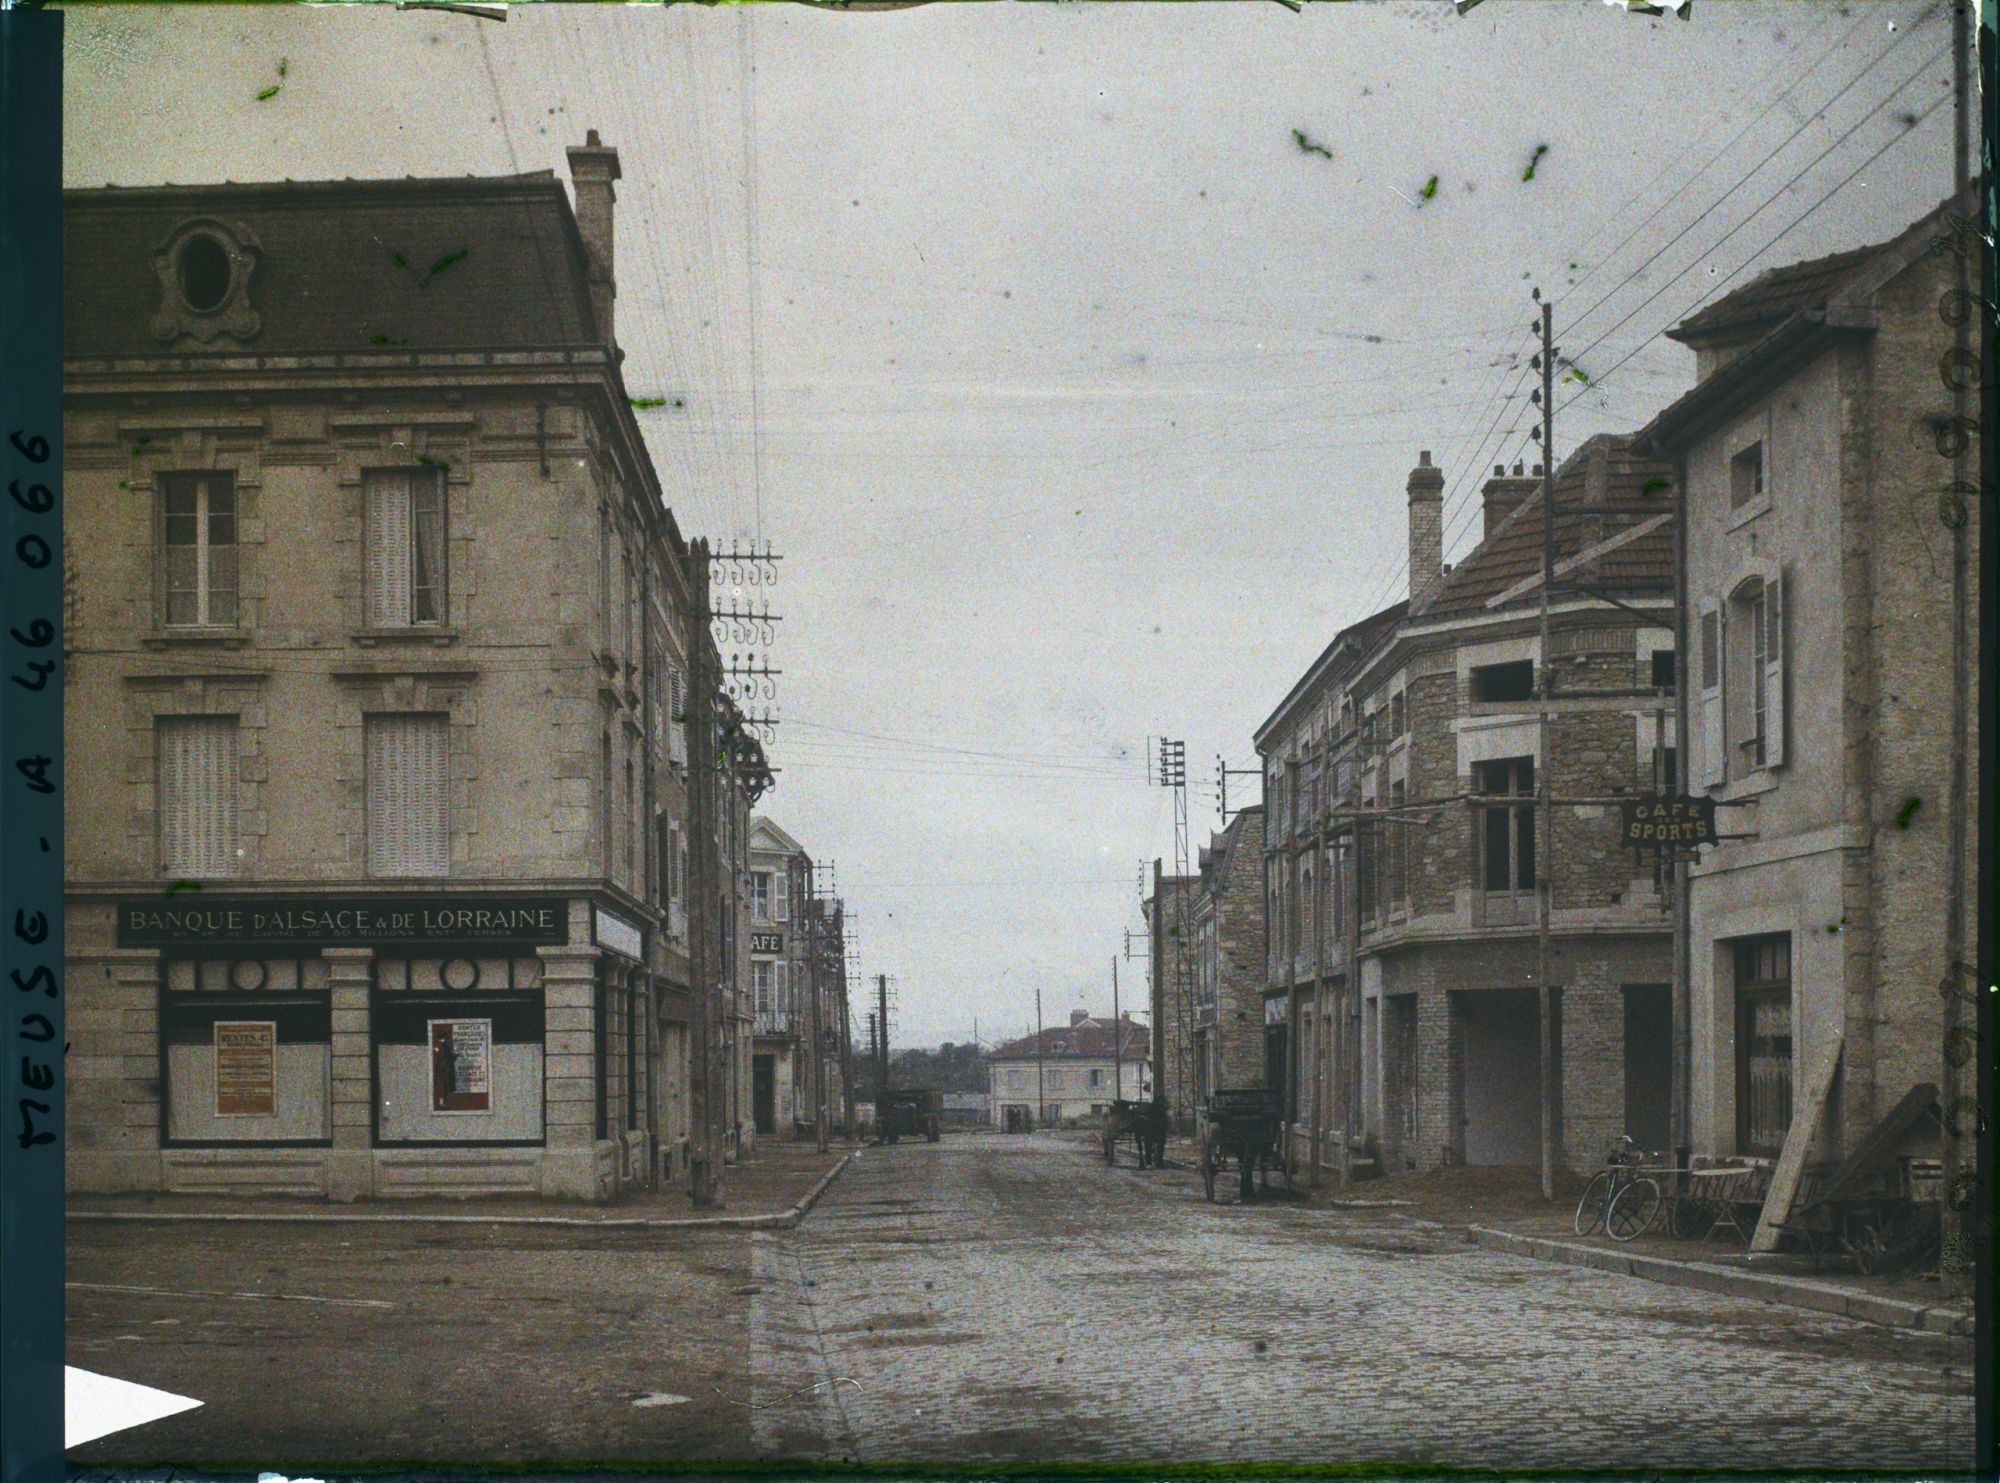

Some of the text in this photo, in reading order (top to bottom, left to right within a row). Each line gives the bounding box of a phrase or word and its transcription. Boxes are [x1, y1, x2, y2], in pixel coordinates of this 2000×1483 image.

[1629, 819, 1708, 840] SPORTS
[129, 910, 244, 931] BANQUE
[376, 916, 388, 929] &
[391, 912, 416, 929] DE
[423, 909, 554, 929] LORRAINE
[359, 930, 416, 938] MILLIONS
